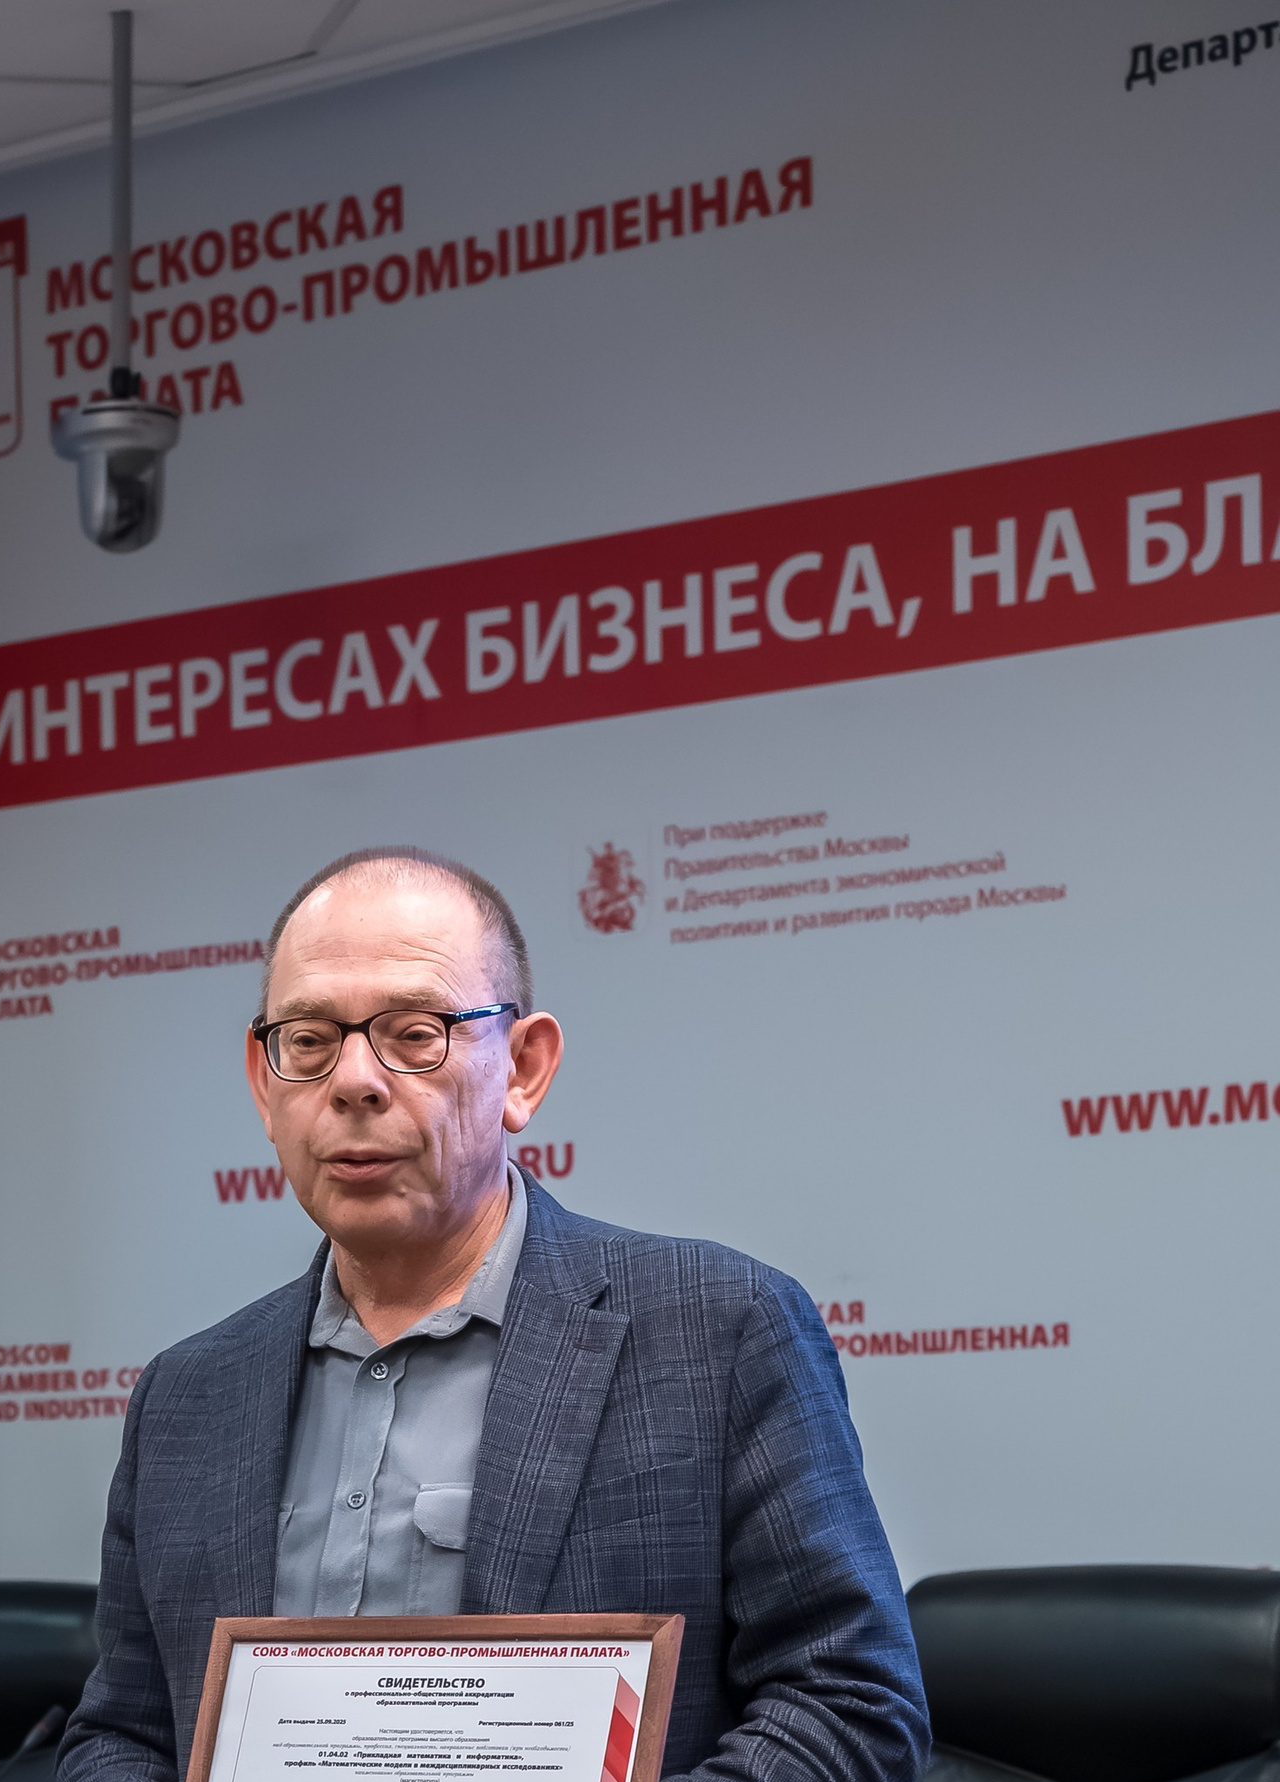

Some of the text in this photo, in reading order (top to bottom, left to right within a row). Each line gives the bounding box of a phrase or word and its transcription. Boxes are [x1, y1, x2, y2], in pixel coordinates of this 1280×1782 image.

[1125, 20, 1280, 92] Департ
[46, 184, 404, 314] МОСКОВСКАЯ
[464, 542, 923, 694] БИЗНЕСА,
[951, 506, 1096, 614] НА
[664, 811, 828, 847] При поддержке
[664, 834, 910, 880] Правительства Москвы
[665, 851, 1006, 913] и Департамента экономической
[671, 884, 1066, 944] политики и развития города Москвы
[214, 1165, 286, 1204] WW
[832, 1322, 1070, 1358] РОМЫШЛЕННАЯ
[82, 1368, 110, 1389] OF
[252, 1646, 630, 1658] СОЮЗ «МОСКОВСКАЯ ТОРГОВО-ПРОМЫШЛЕННАЯ ПАЛАТА»
[350, 1690, 464, 1699] профессионально-общественной
[465, 1691, 514, 1699] аккредитации
[377, 1677, 486, 1689] СВИДЕТЕЛЬСТВО
[376, 1699, 479, 1708] образовательной программы
[478, 1720, 533, 1728] Регистрационный
[318, 1760, 382, 1768] «Математические
[502, 1763, 563, 1771] исследованиях»
[353, 1751, 401, 1759] «Прикладная
[466, 1753, 524, 1761] информатика»,
